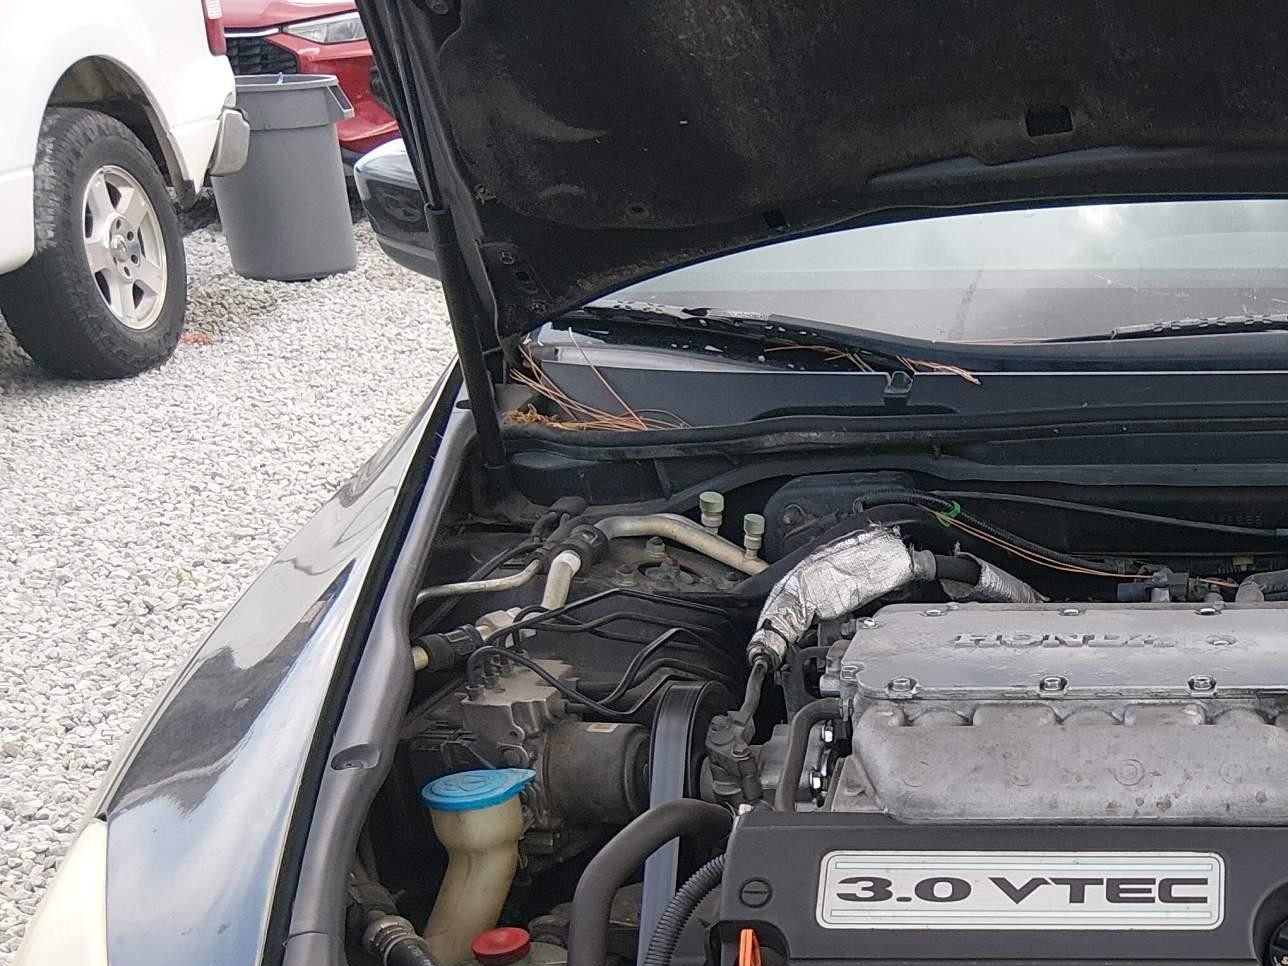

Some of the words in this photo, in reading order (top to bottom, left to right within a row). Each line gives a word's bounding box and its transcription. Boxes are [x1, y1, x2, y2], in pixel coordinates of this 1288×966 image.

[951, 632, 1178, 649] HONDA
[836, 876, 973, 904] 3.0
[989, 877, 1210, 905] VTEC
